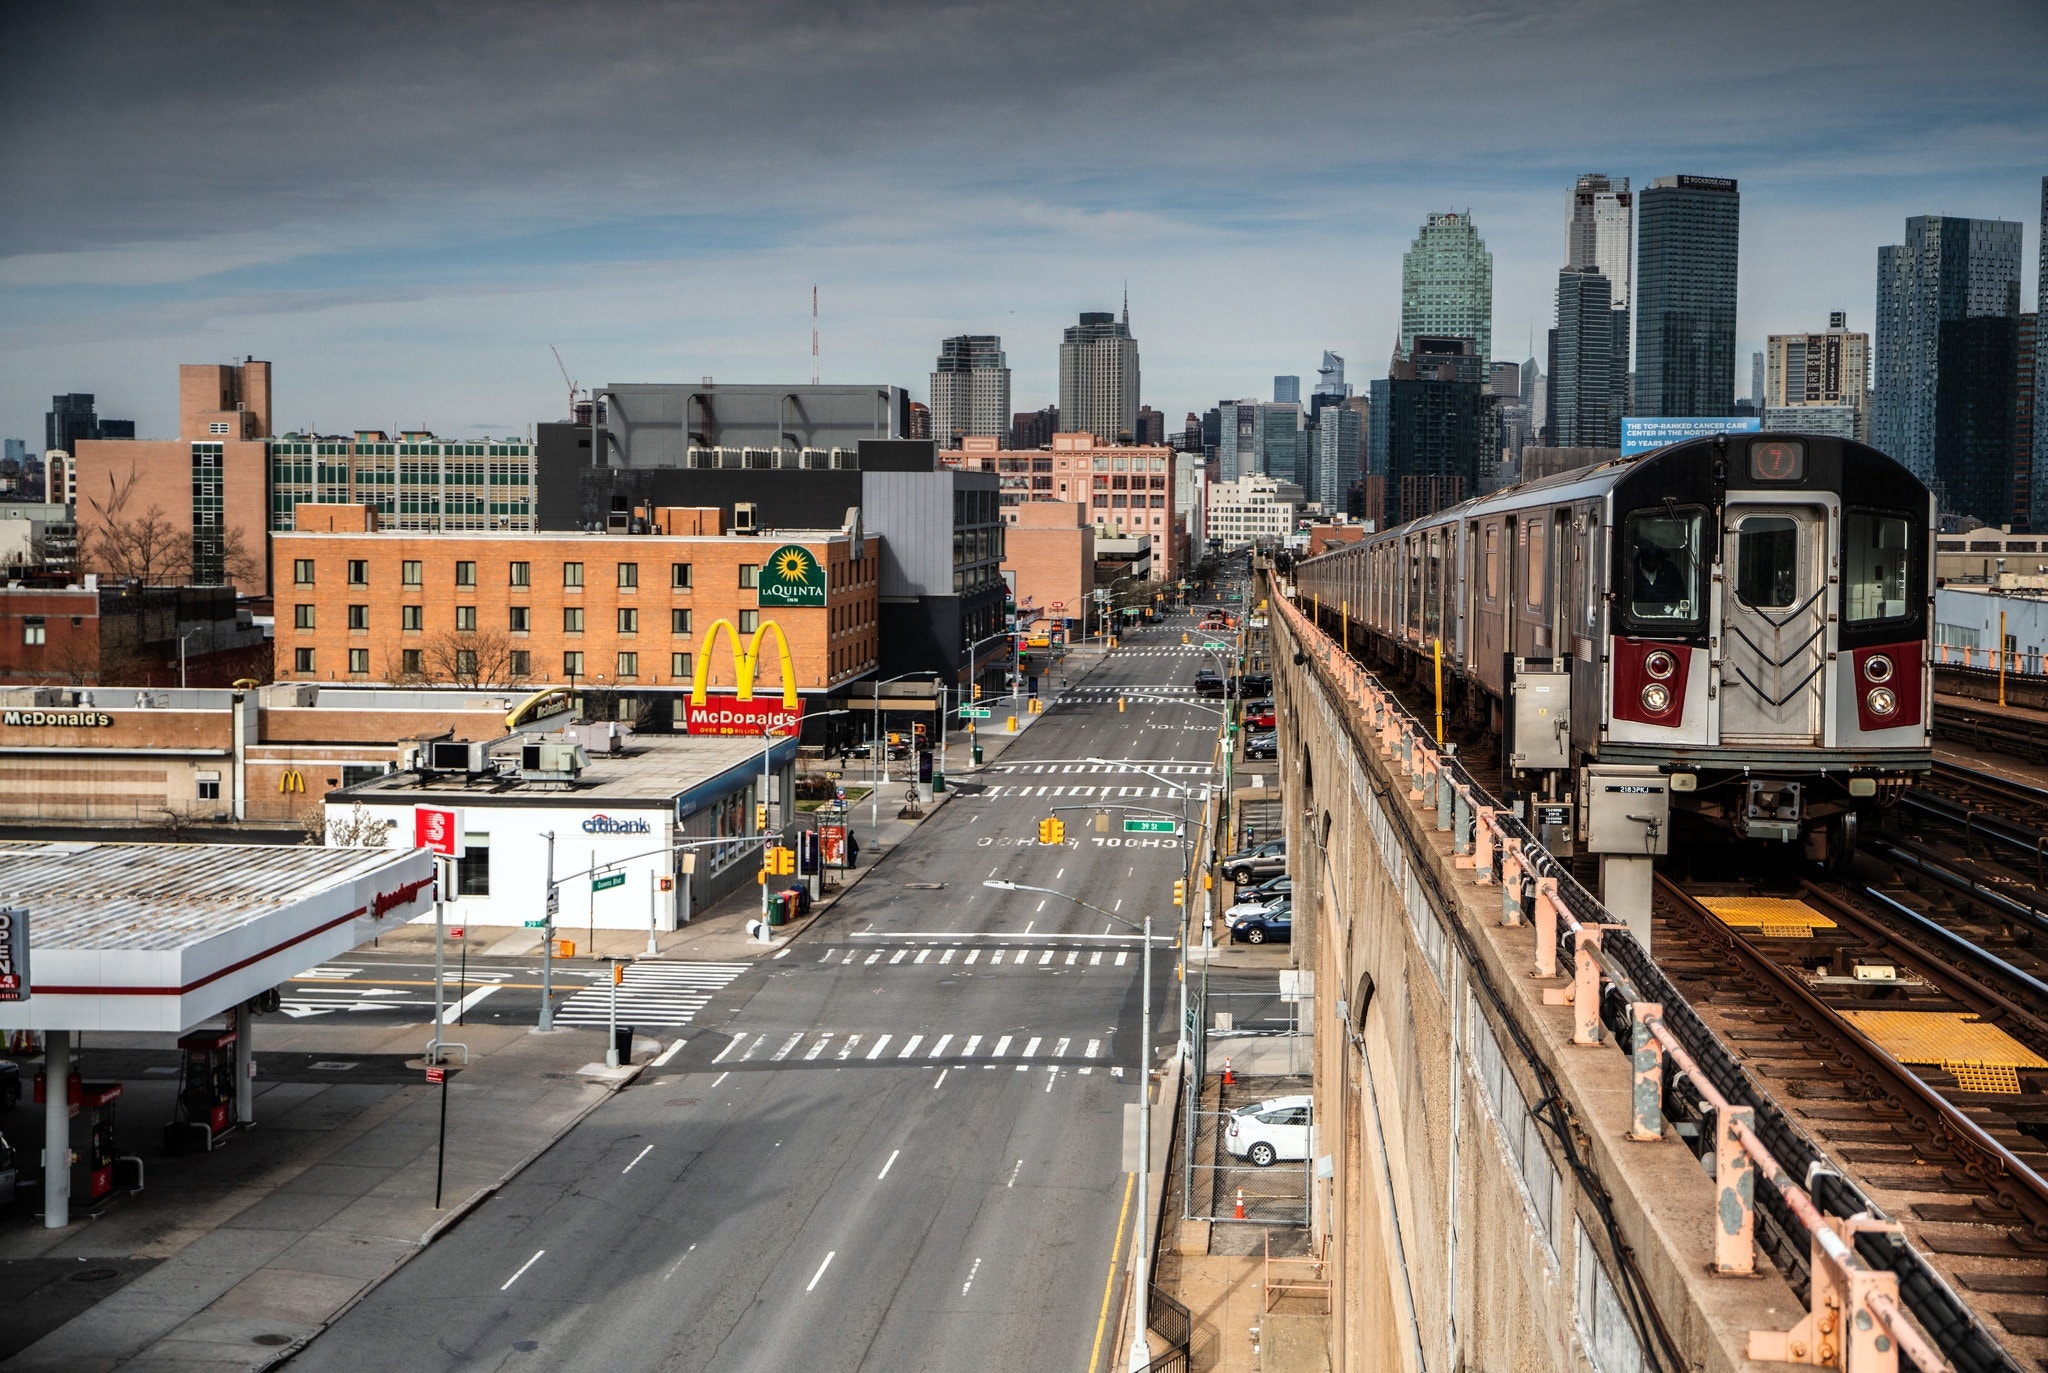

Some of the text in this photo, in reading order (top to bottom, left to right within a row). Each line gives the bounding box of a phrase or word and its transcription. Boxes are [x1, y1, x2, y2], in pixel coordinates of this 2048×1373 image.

[1690, 177, 1732, 186] ROCKROSE.COM
[1626, 429, 1657, 437] CENTER
[1769, 449, 1783, 470] 7
[4, 711, 109, 726] McDonald's
[690, 709, 796, 727] McDonald's
[720, 727, 734, 735] 99
[1620, 786, 1649, 794] 2183PKJ
[581, 814, 650, 834] citibank
[1140, 822, 1159, 831] 39 St
[597, 877, 623, 889] Queens Blvd
